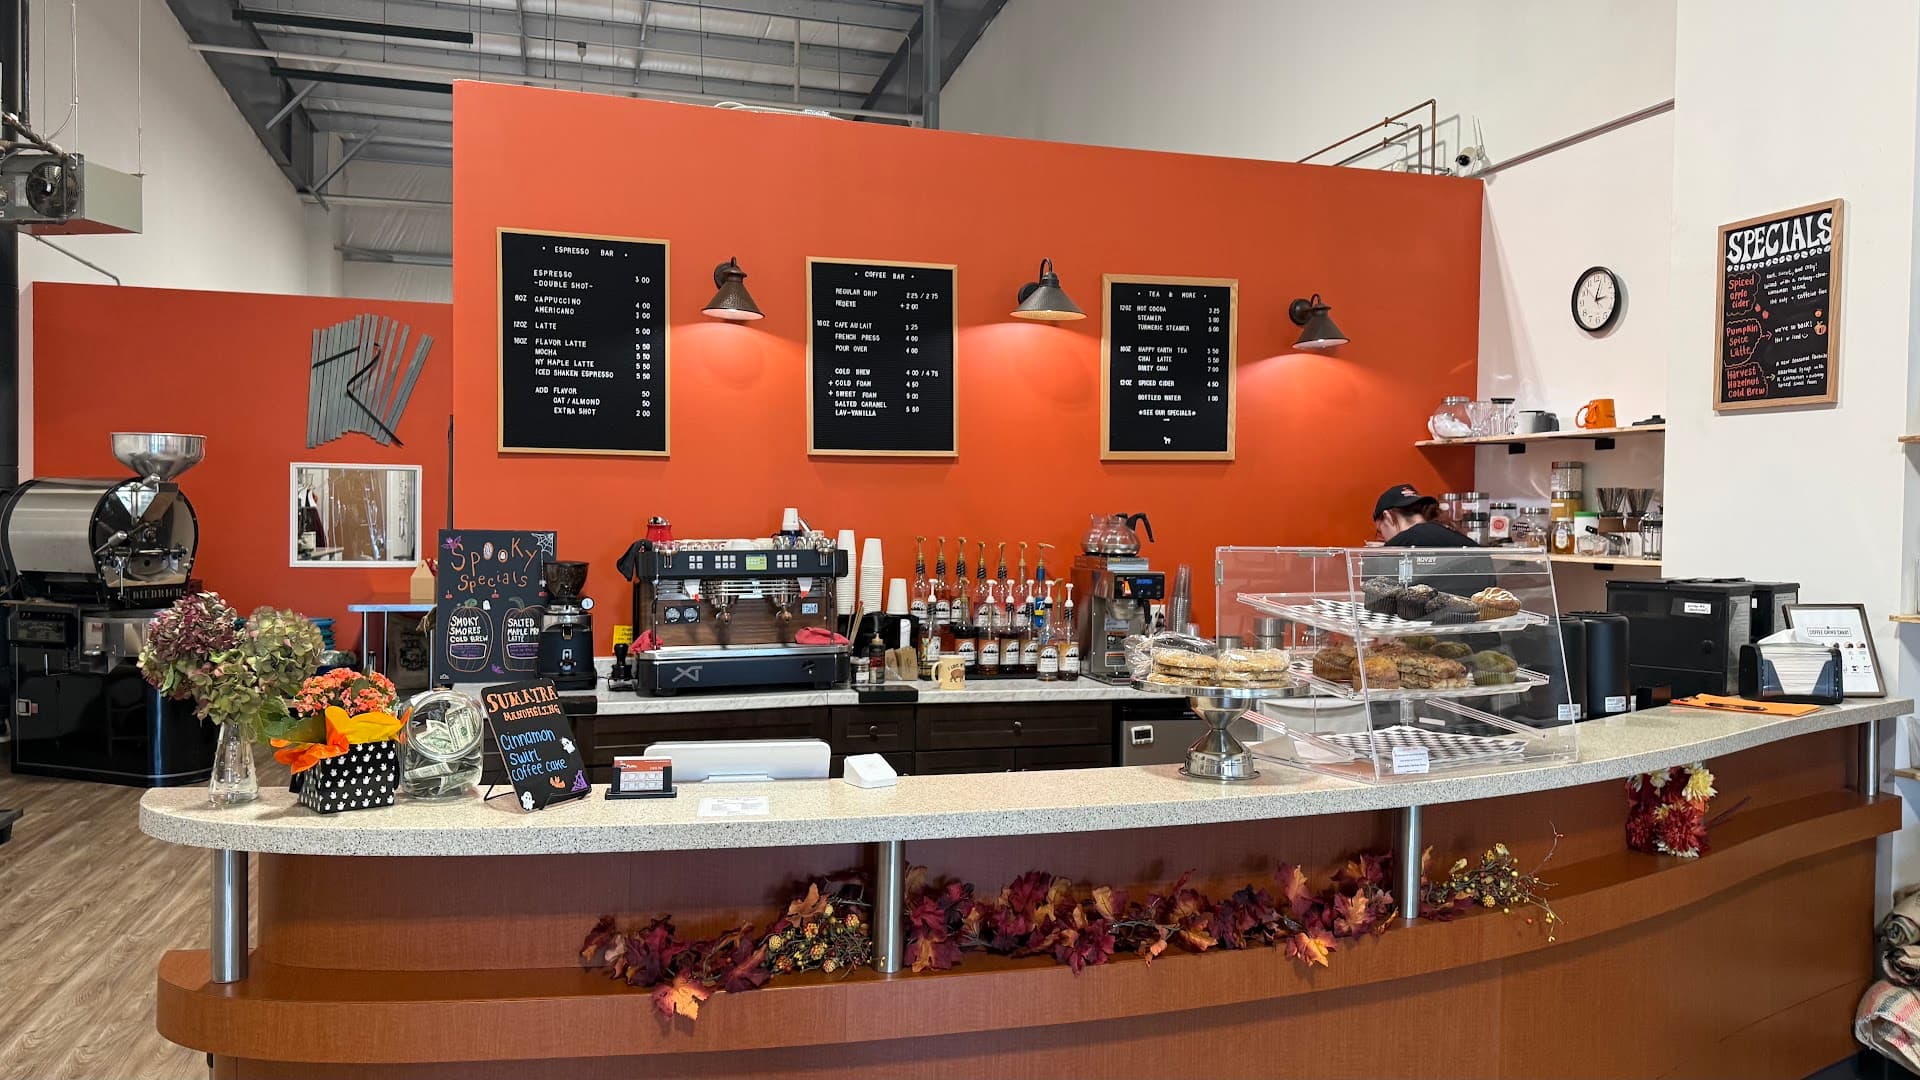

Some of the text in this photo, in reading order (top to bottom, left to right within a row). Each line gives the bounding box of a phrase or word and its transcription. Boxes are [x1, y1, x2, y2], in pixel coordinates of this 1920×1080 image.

[1727, 212, 1832, 264] SPECIALS
[555, 246, 589, 255] ESPRESSO
[534, 269, 572, 278] ESPRESSO
[1729, 274, 1755, 291] Spiced
[534, 296, 581, 305] CAPPUCCINO
[535, 306, 574, 315] AMERICANO
[535, 322, 556, 330] LATTE
[1726, 323, 1758, 336] Pumpkin
[535, 338, 561, 346] FLAVOR
[1729, 335, 1749, 347] Spice
[535, 348, 557, 356] MOCHA
[1730, 345, 1751, 358] Latte
[554, 369, 578, 377] SHAKEN
[581, 370, 614, 378] ESPRESSO
[1727, 366, 1757, 380] Harvest
[1727, 377, 1759, 389] Hazelnut
[1747, 386, 1765, 397] Brew
[450, 615, 479, 627] SMOKY
[507, 618, 535, 627] SALTED
[449, 626, 481, 635] SMORES
[507, 628, 528, 636] MAPLE
[449, 635, 468, 643] COLD
[487, 685, 559, 713] SUMATRA
[503, 704, 561, 721] MANDHELING
[500, 729, 556, 750] Cinnamon
[511, 763, 544, 782] coffee
